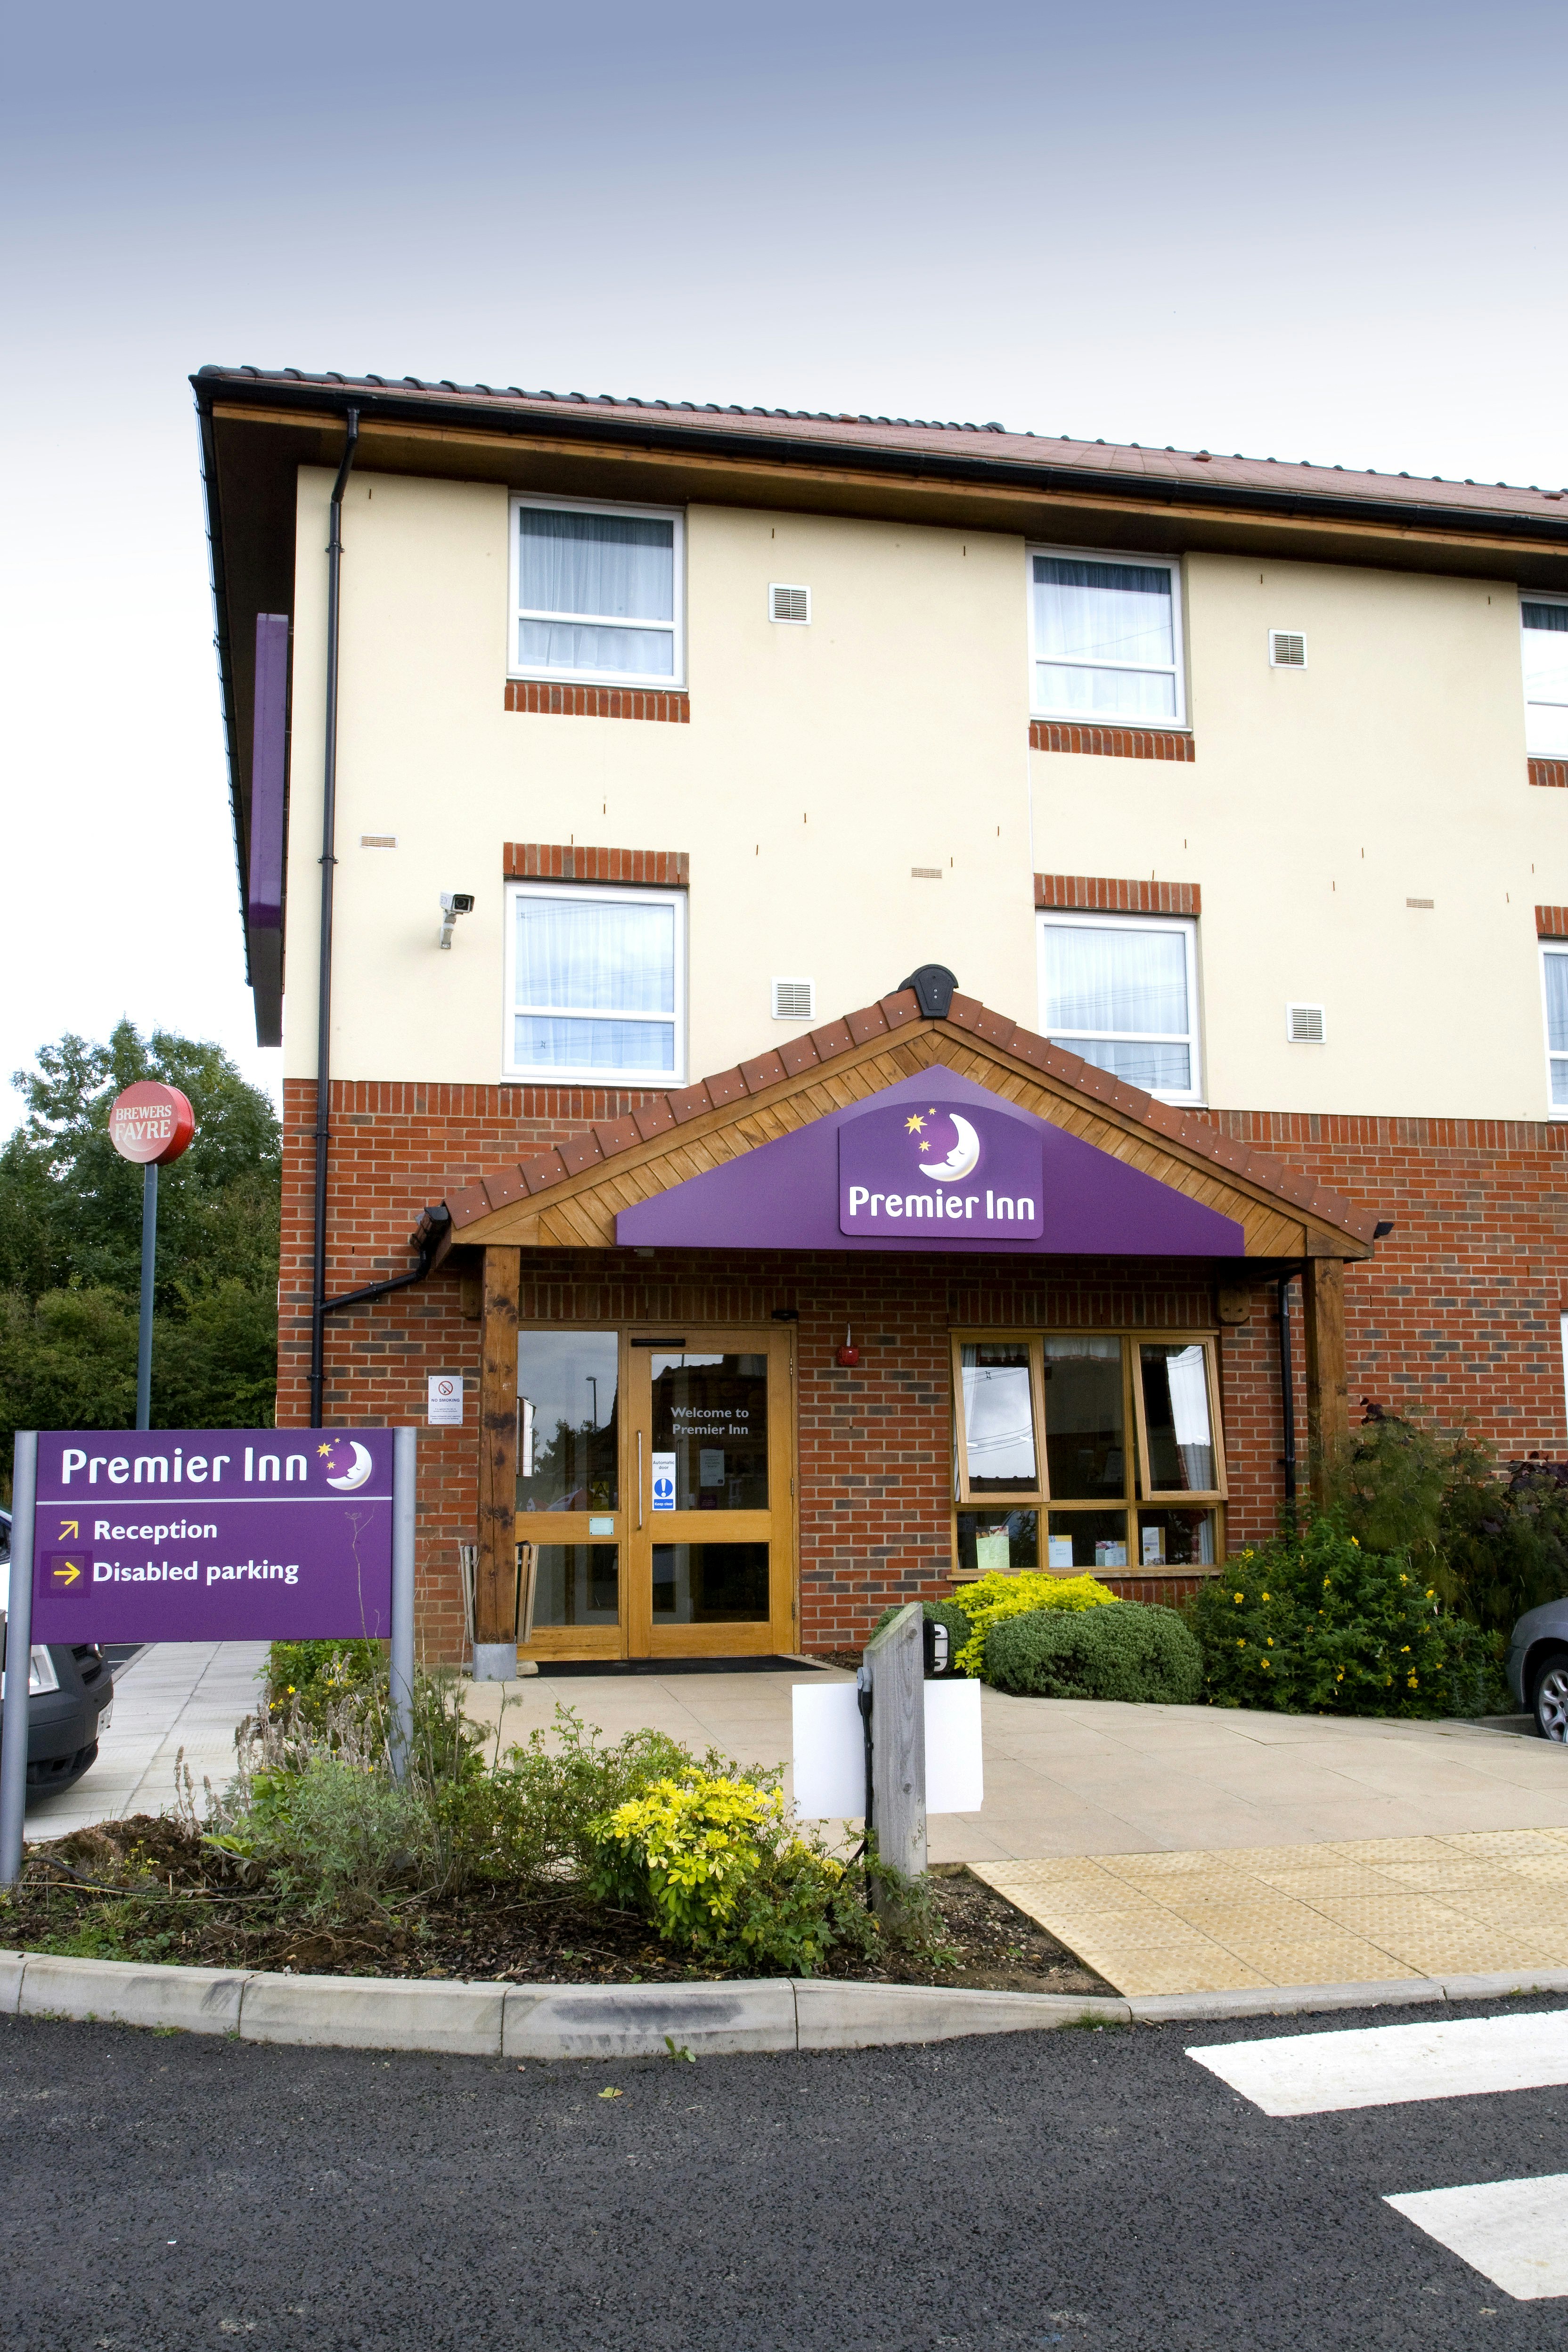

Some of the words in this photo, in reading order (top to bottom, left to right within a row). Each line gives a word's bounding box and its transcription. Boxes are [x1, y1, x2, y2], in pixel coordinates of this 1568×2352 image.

[116, 1105, 172, 1120] BREWERS
[115, 1119, 171, 1142] FAYRE
[849, 1186, 979, 1219] Premier
[987, 1190, 1035, 1220] Inn
[671, 1407, 732, 1418] Welcome
[736, 1408, 749, 1418] to
[672, 1424, 725, 1435] Premier
[729, 1424, 748, 1434] Inn
[62, 1448, 230, 1484] Premier
[244, 1447, 307, 1481] Inn
[94, 1519, 217, 1545] Reception
[93, 1561, 198, 1582] Disabled
[206, 1560, 299, 1586] parking
